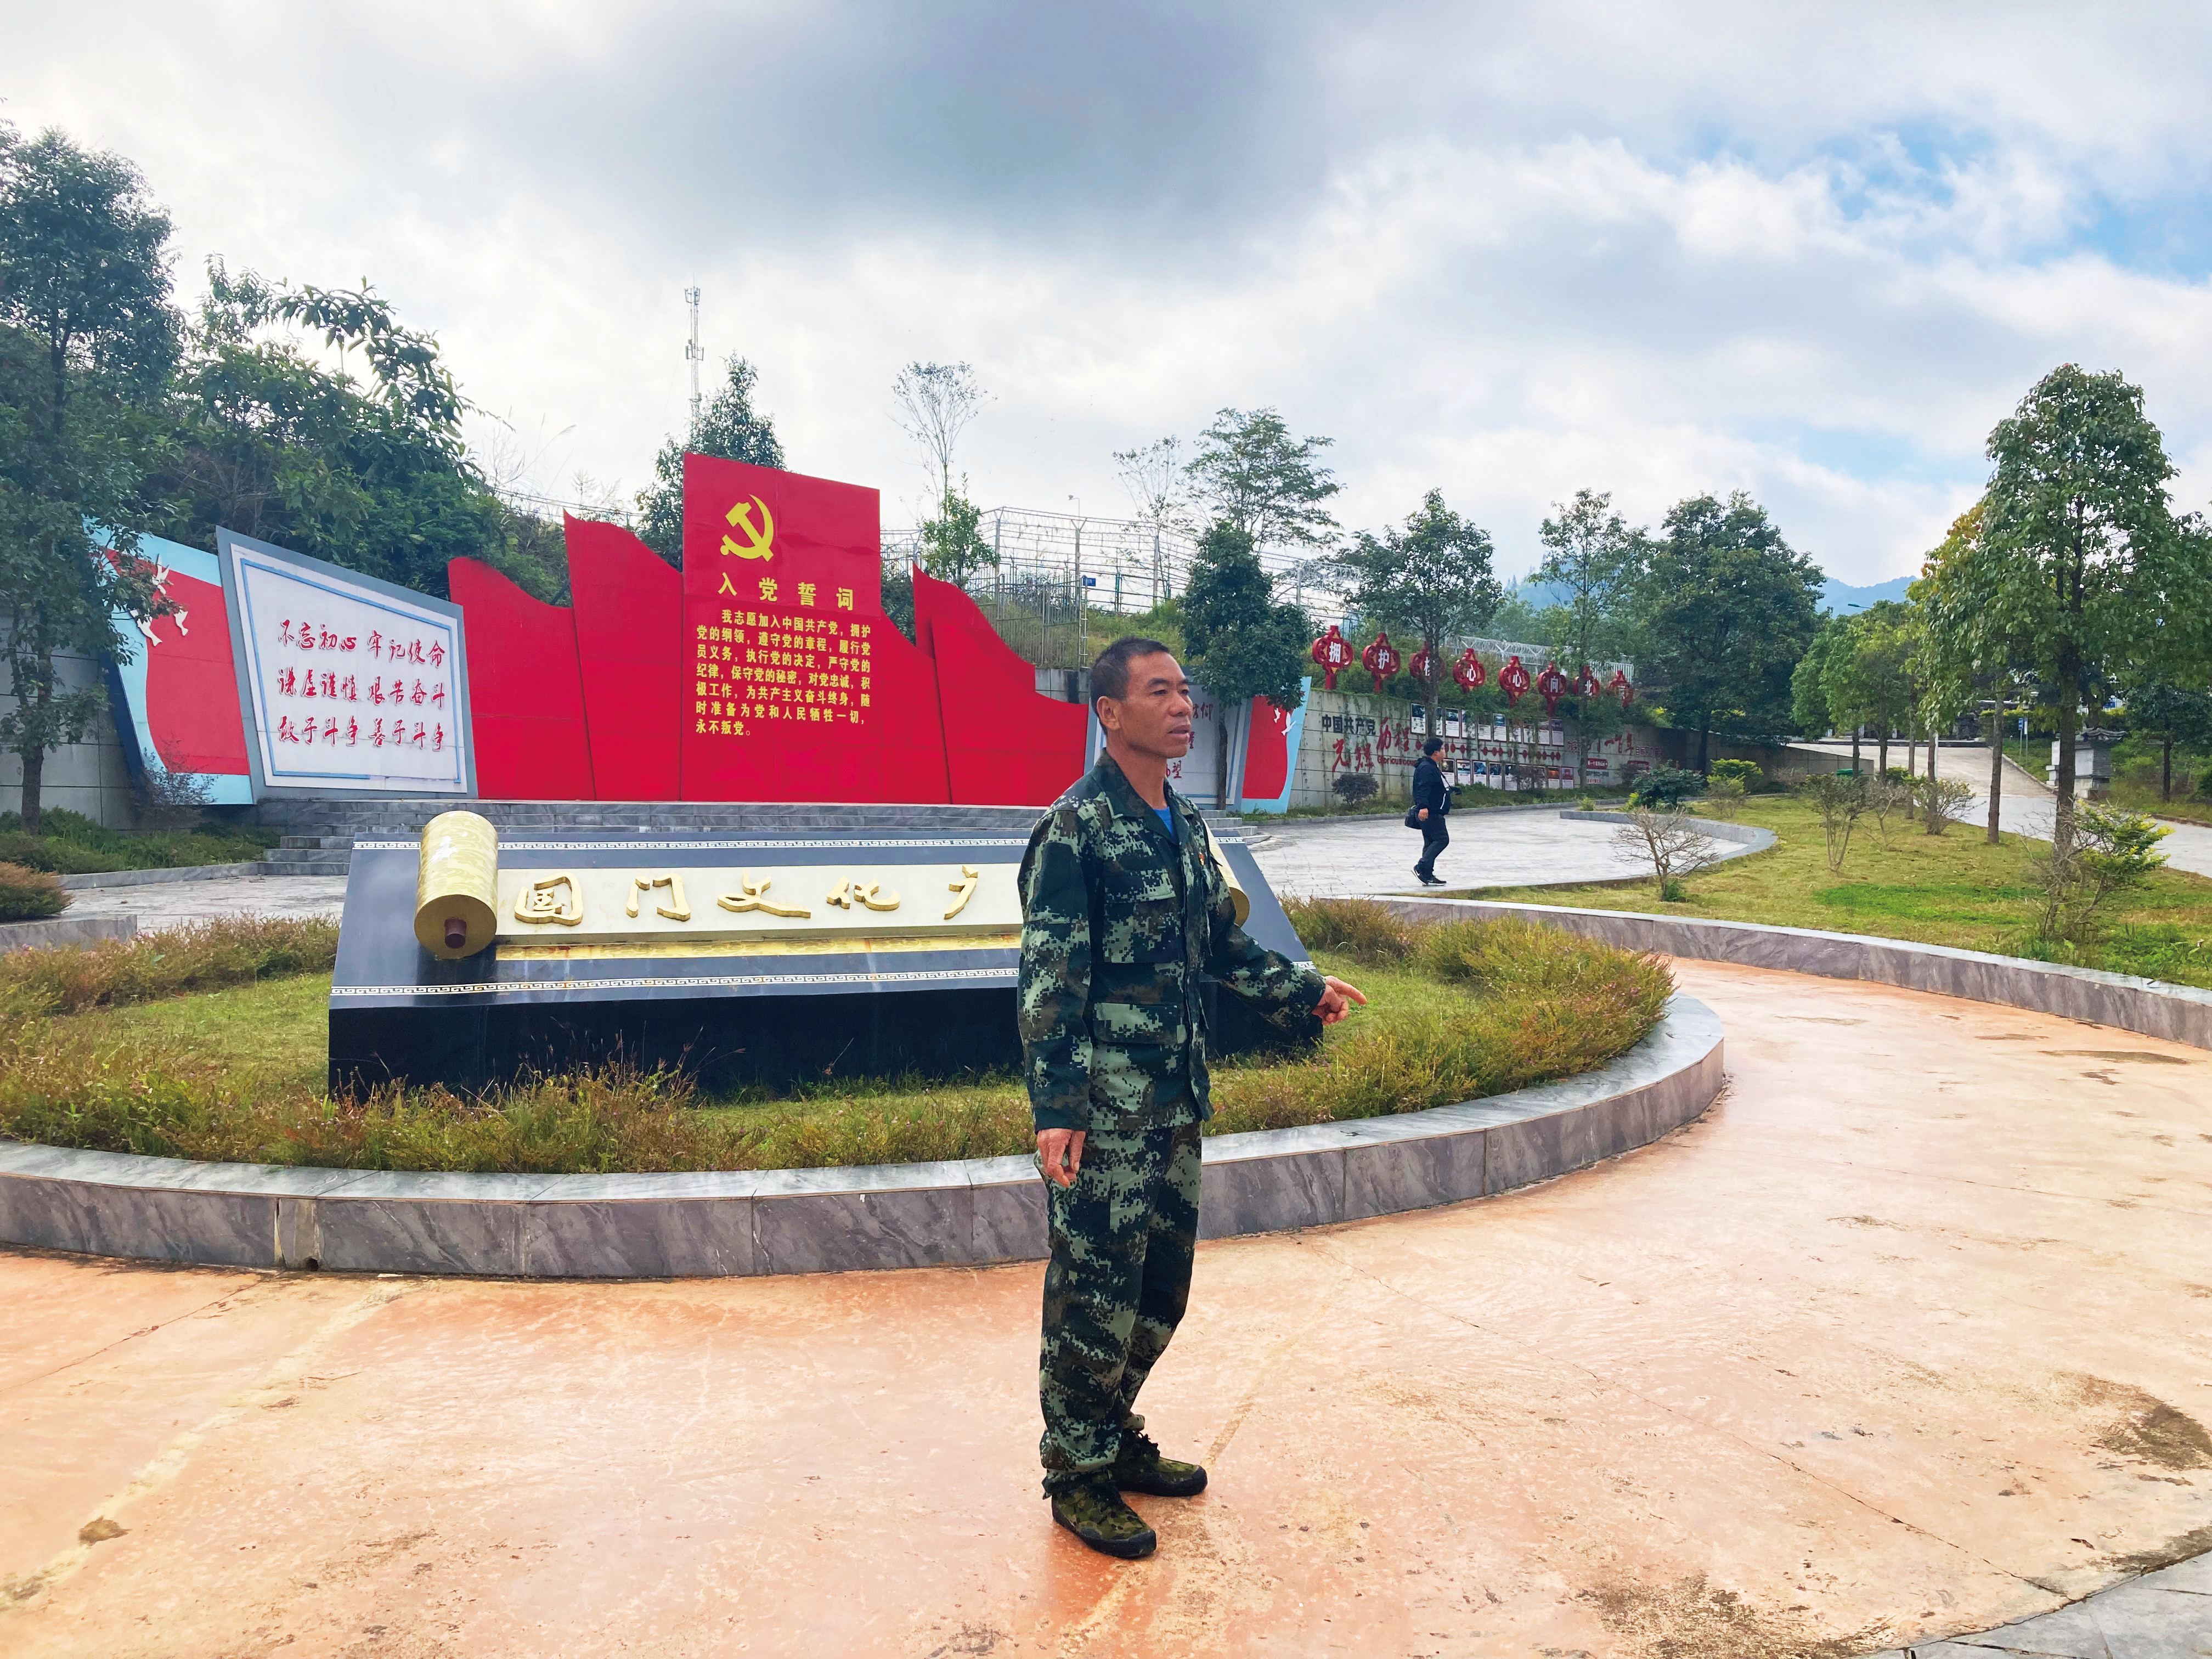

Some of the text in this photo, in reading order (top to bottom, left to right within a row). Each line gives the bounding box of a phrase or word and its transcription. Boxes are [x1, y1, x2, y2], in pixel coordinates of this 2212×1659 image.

[718, 572, 854, 611] 入党誓词
[721, 609, 871, 638] 我志愿加入中国共产党，拥护
[279, 619, 445, 667] 不忘初心 牢记使命
[696, 625, 871, 656] 党的纲领，遵守党的章程，履行党
[696, 644, 871, 673] 员义务，执行党的决定，严守党的
[279, 667, 445, 708] 谦虚谨慎 艰苦奋斗
[696, 663, 870, 690] 纪律，保守党的秘密，对党忠诚，积
[696, 681, 870, 708] 极工作，为共产主义奋斗终身，随
[696, 701, 865, 725] 时准备为党和人民牺牲一切，
[696, 718, 751, 736] 永不叛党。
[1322, 714, 1376, 735] 中国共产党
[279, 715, 444, 751] 敢于斗争 善于斗争
